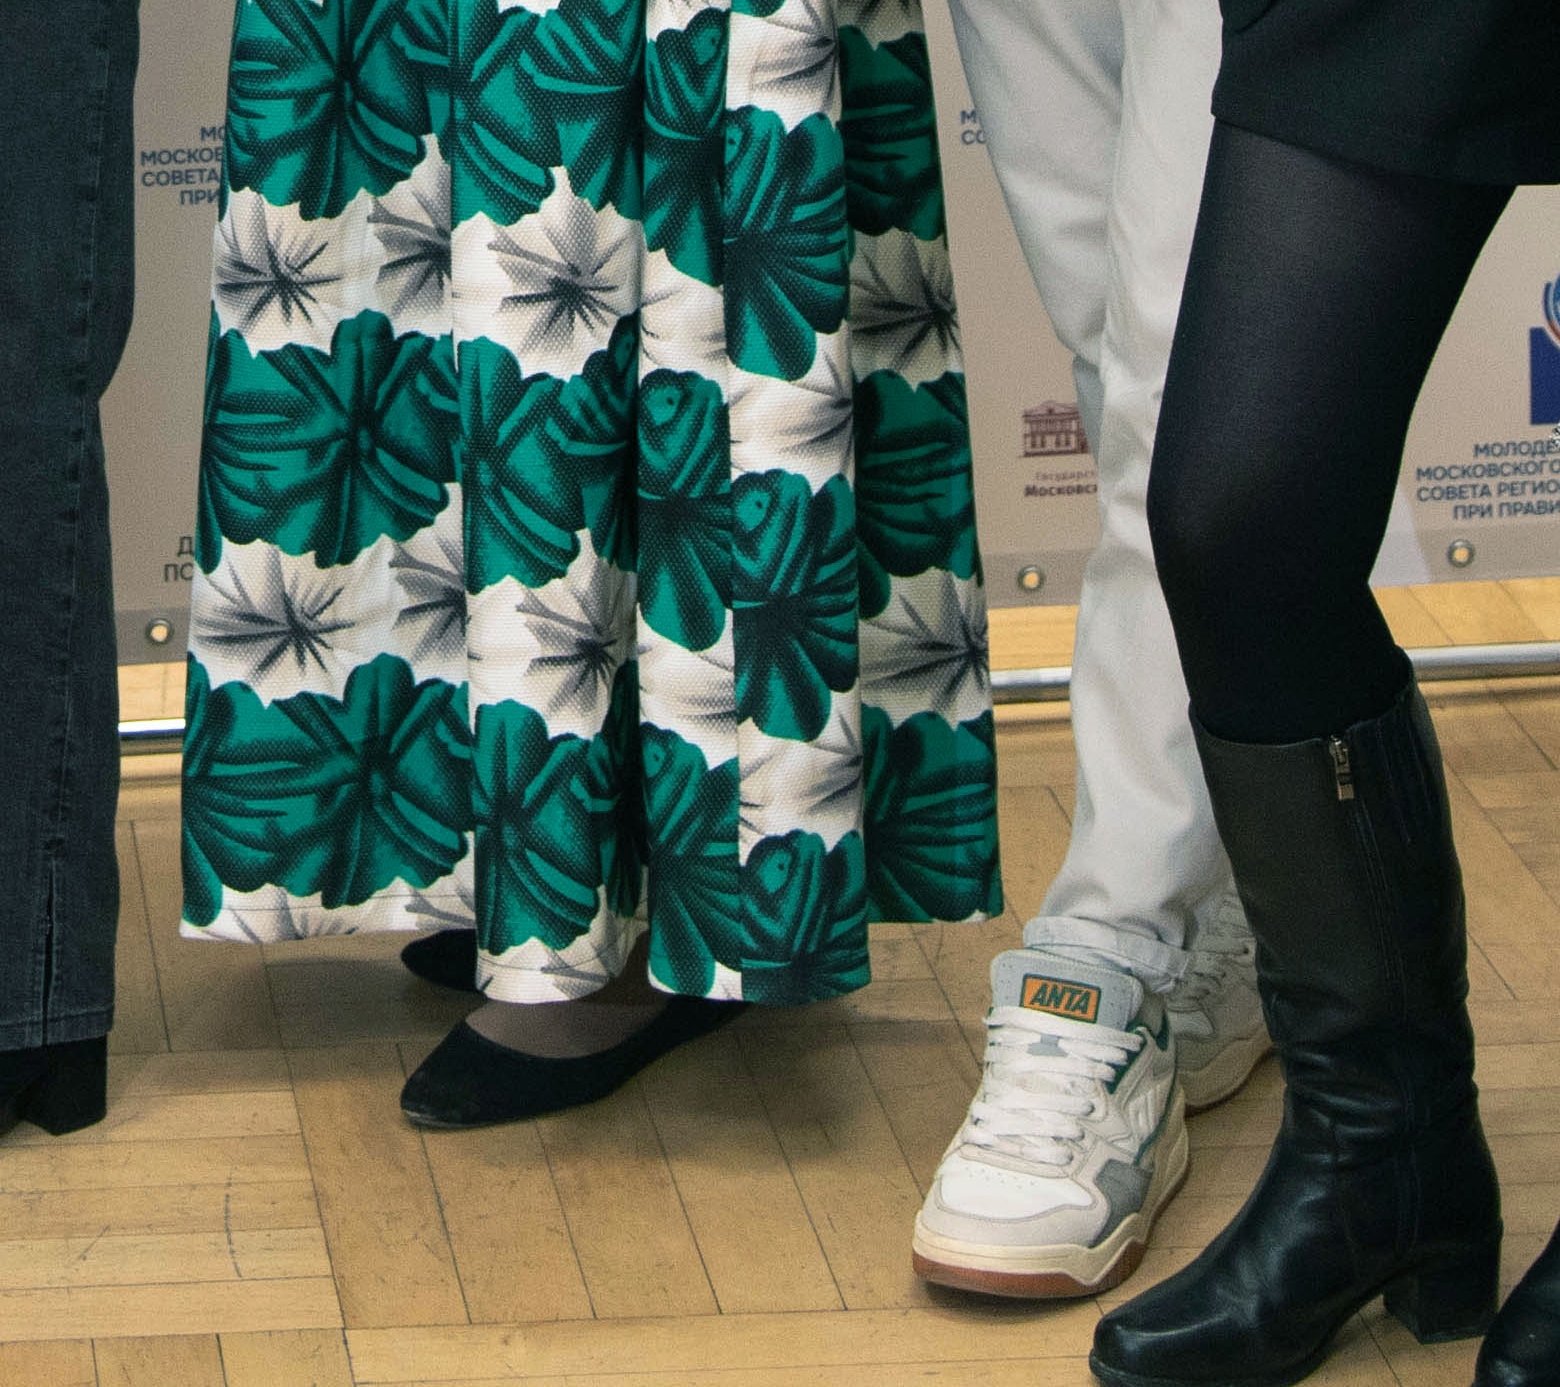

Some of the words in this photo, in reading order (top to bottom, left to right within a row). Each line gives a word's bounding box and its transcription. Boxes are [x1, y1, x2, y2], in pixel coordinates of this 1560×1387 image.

[1416, 484, 1490, 504] СОВЕТА
[1453, 501, 1493, 521] ПРИ
[1027, 981, 1095, 1016] ANTA
